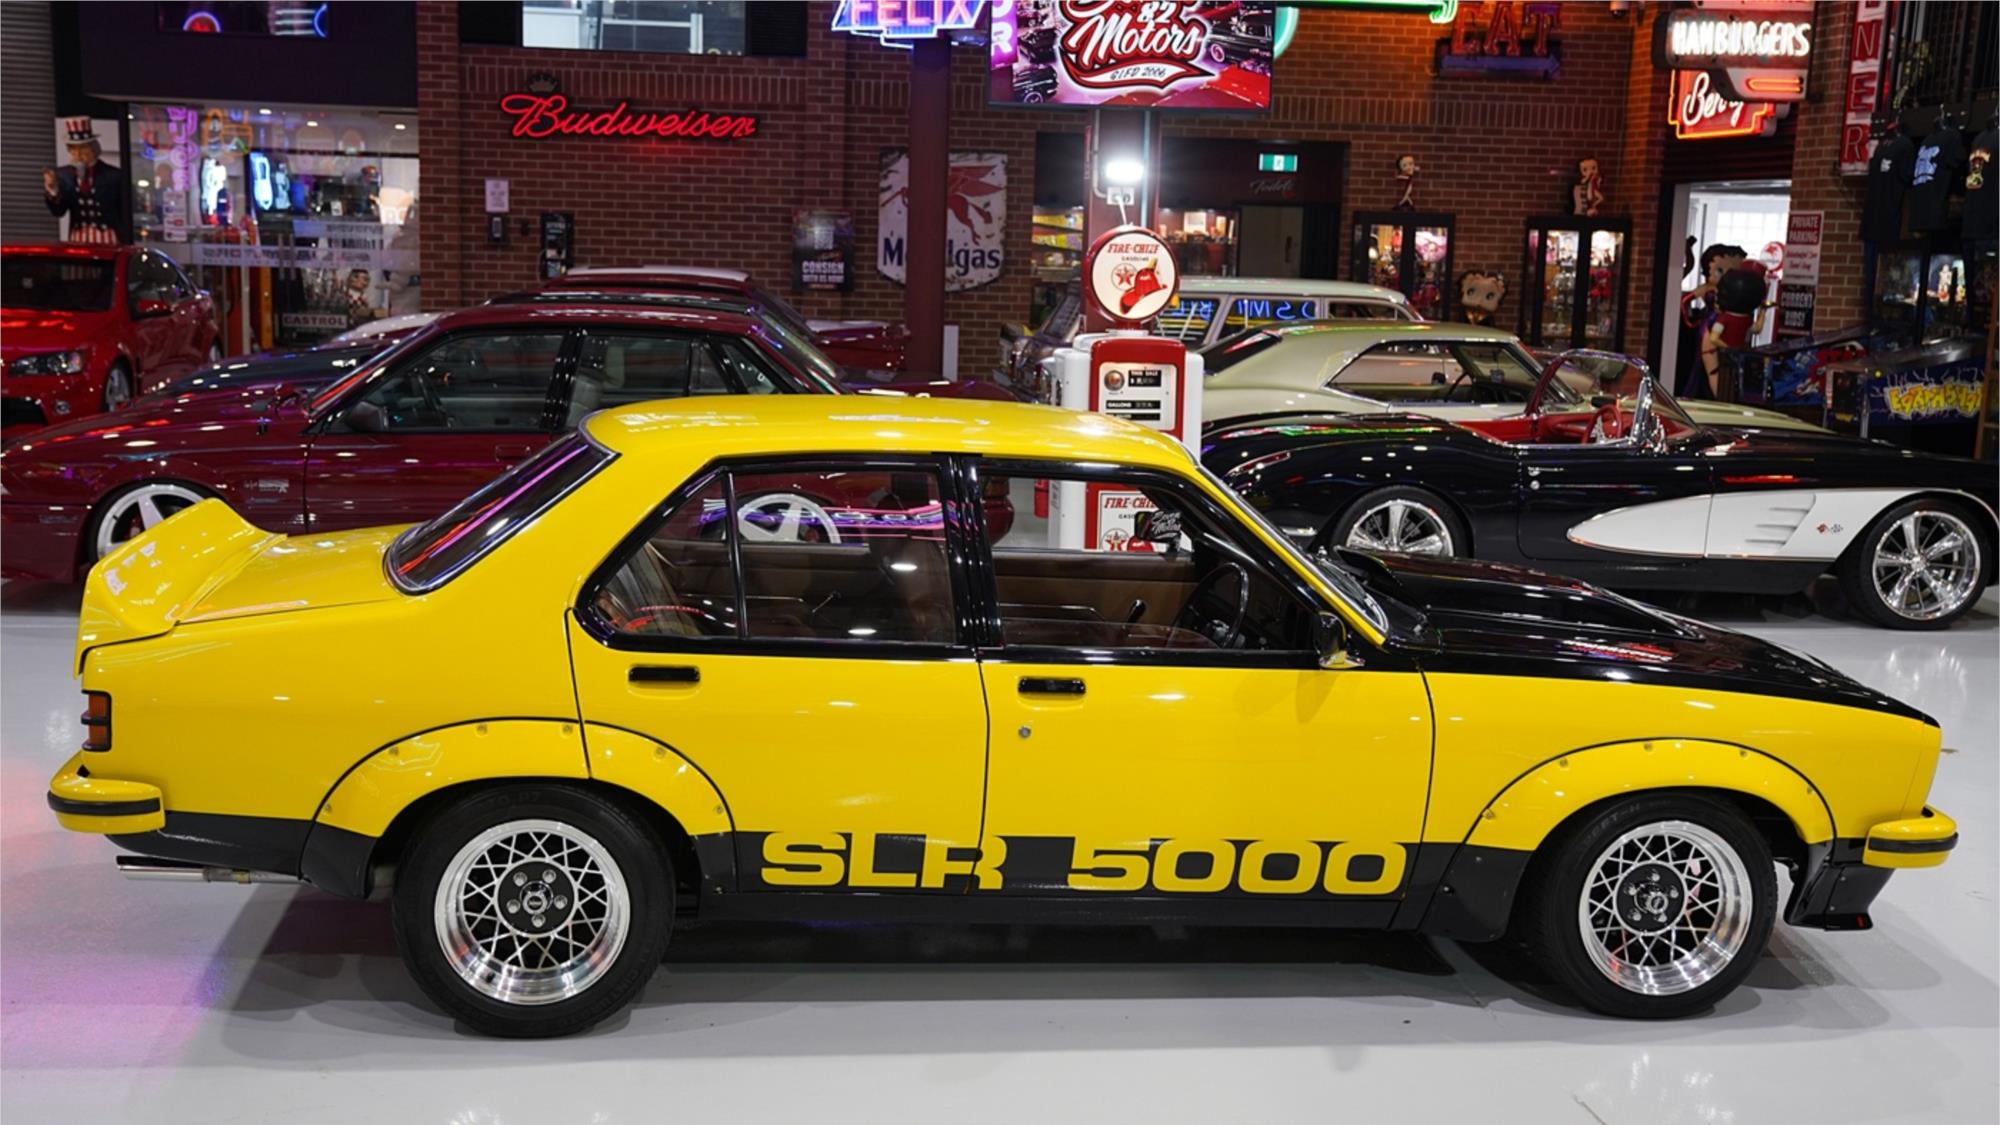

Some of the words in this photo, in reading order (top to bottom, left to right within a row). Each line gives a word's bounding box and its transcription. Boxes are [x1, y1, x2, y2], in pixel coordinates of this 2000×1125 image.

[1067, 12, 1200, 66] Motors
[1452, 2, 1562, 56] EAT
[1672, 20, 1811, 56] HAMBURGERS
[1844, 0, 1877, 160] NER
[501, 94, 757, 138] Budweiser
[883, 238, 1001, 276] Mlgas
[1789, 230, 1818, 243] PARKING
[802, 260, 844, 274] CONSIGN
[283, 315, 346, 326] CASTROL
[761, 831, 1008, 891] SLR
[1067, 838, 1408, 896] 5000
